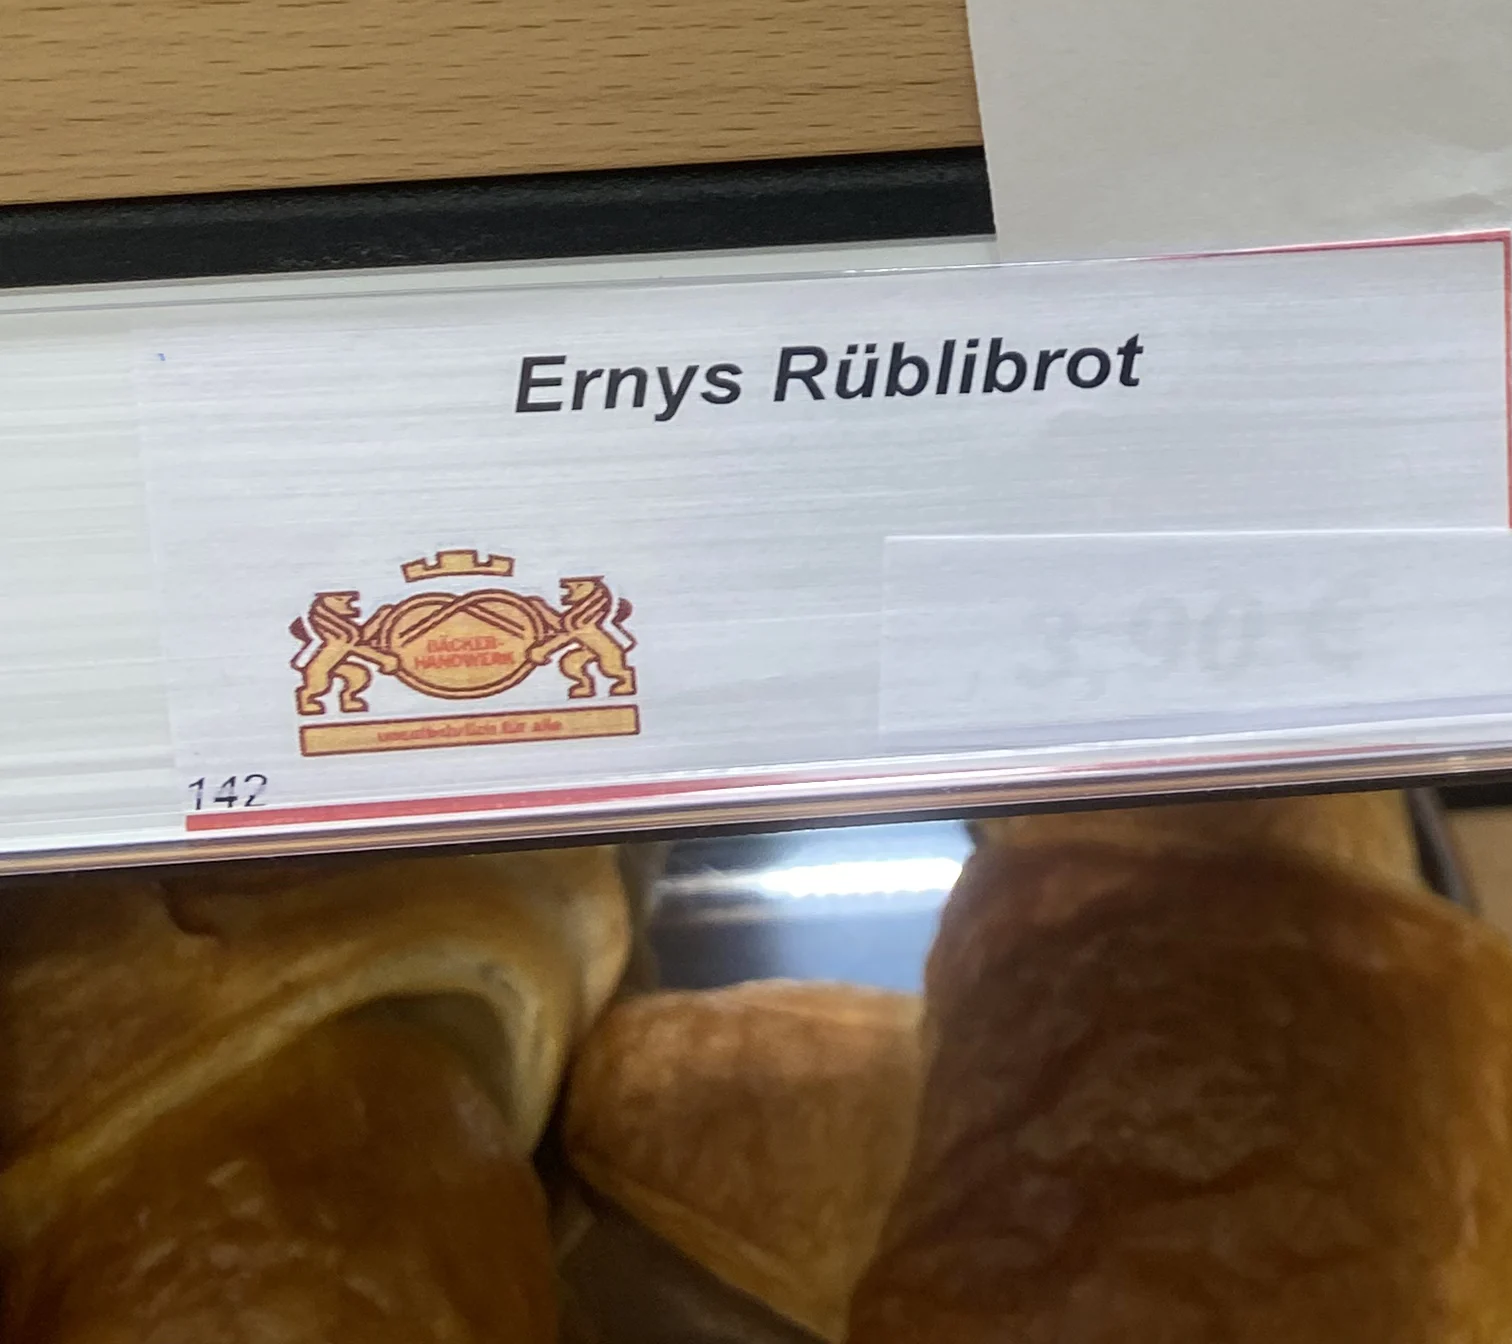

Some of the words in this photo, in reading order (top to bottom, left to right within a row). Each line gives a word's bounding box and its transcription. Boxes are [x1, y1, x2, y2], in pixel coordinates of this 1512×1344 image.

[515, 354, 742, 423] Ernys
[773, 333, 1144, 403] Rüblibrot
[188, 773, 268, 810] 142
